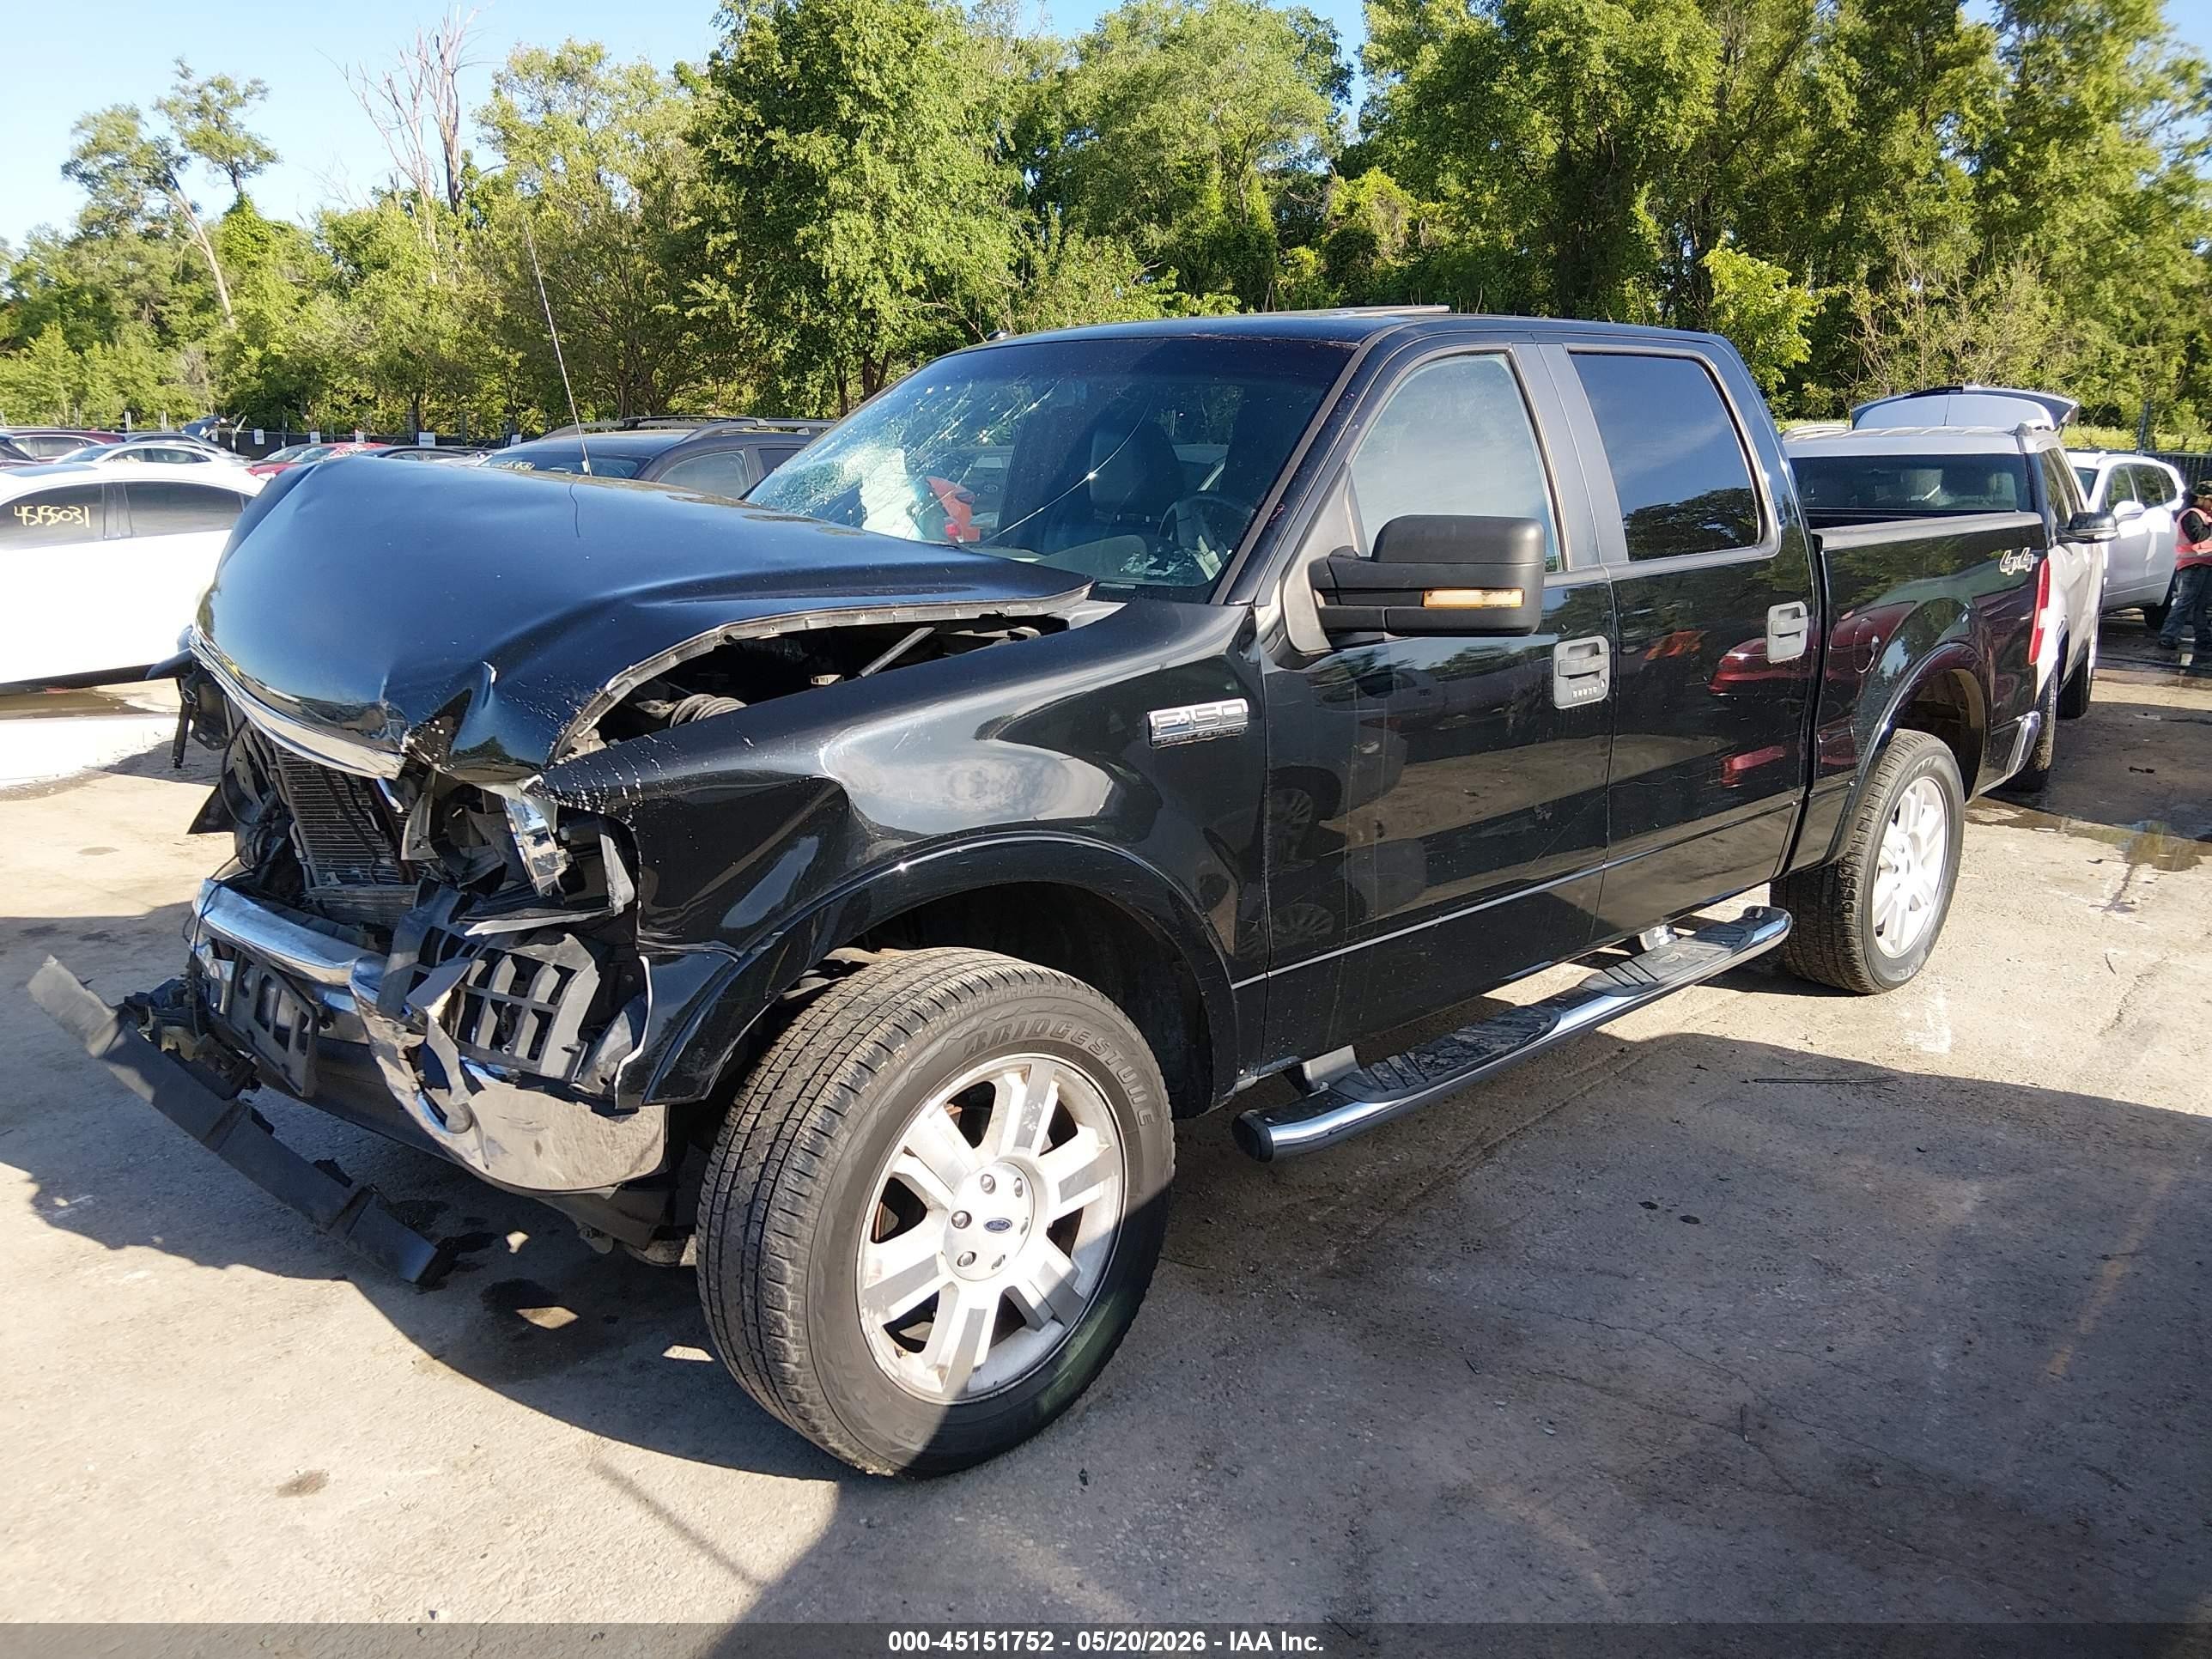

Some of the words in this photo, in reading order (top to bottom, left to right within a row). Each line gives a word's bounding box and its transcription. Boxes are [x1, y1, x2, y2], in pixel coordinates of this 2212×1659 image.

[14, 505, 90, 528] 45155031
[1999, 547, 2034, 576] 4x4
[963, 1018, 1155, 1127] BRIDGESTONE
